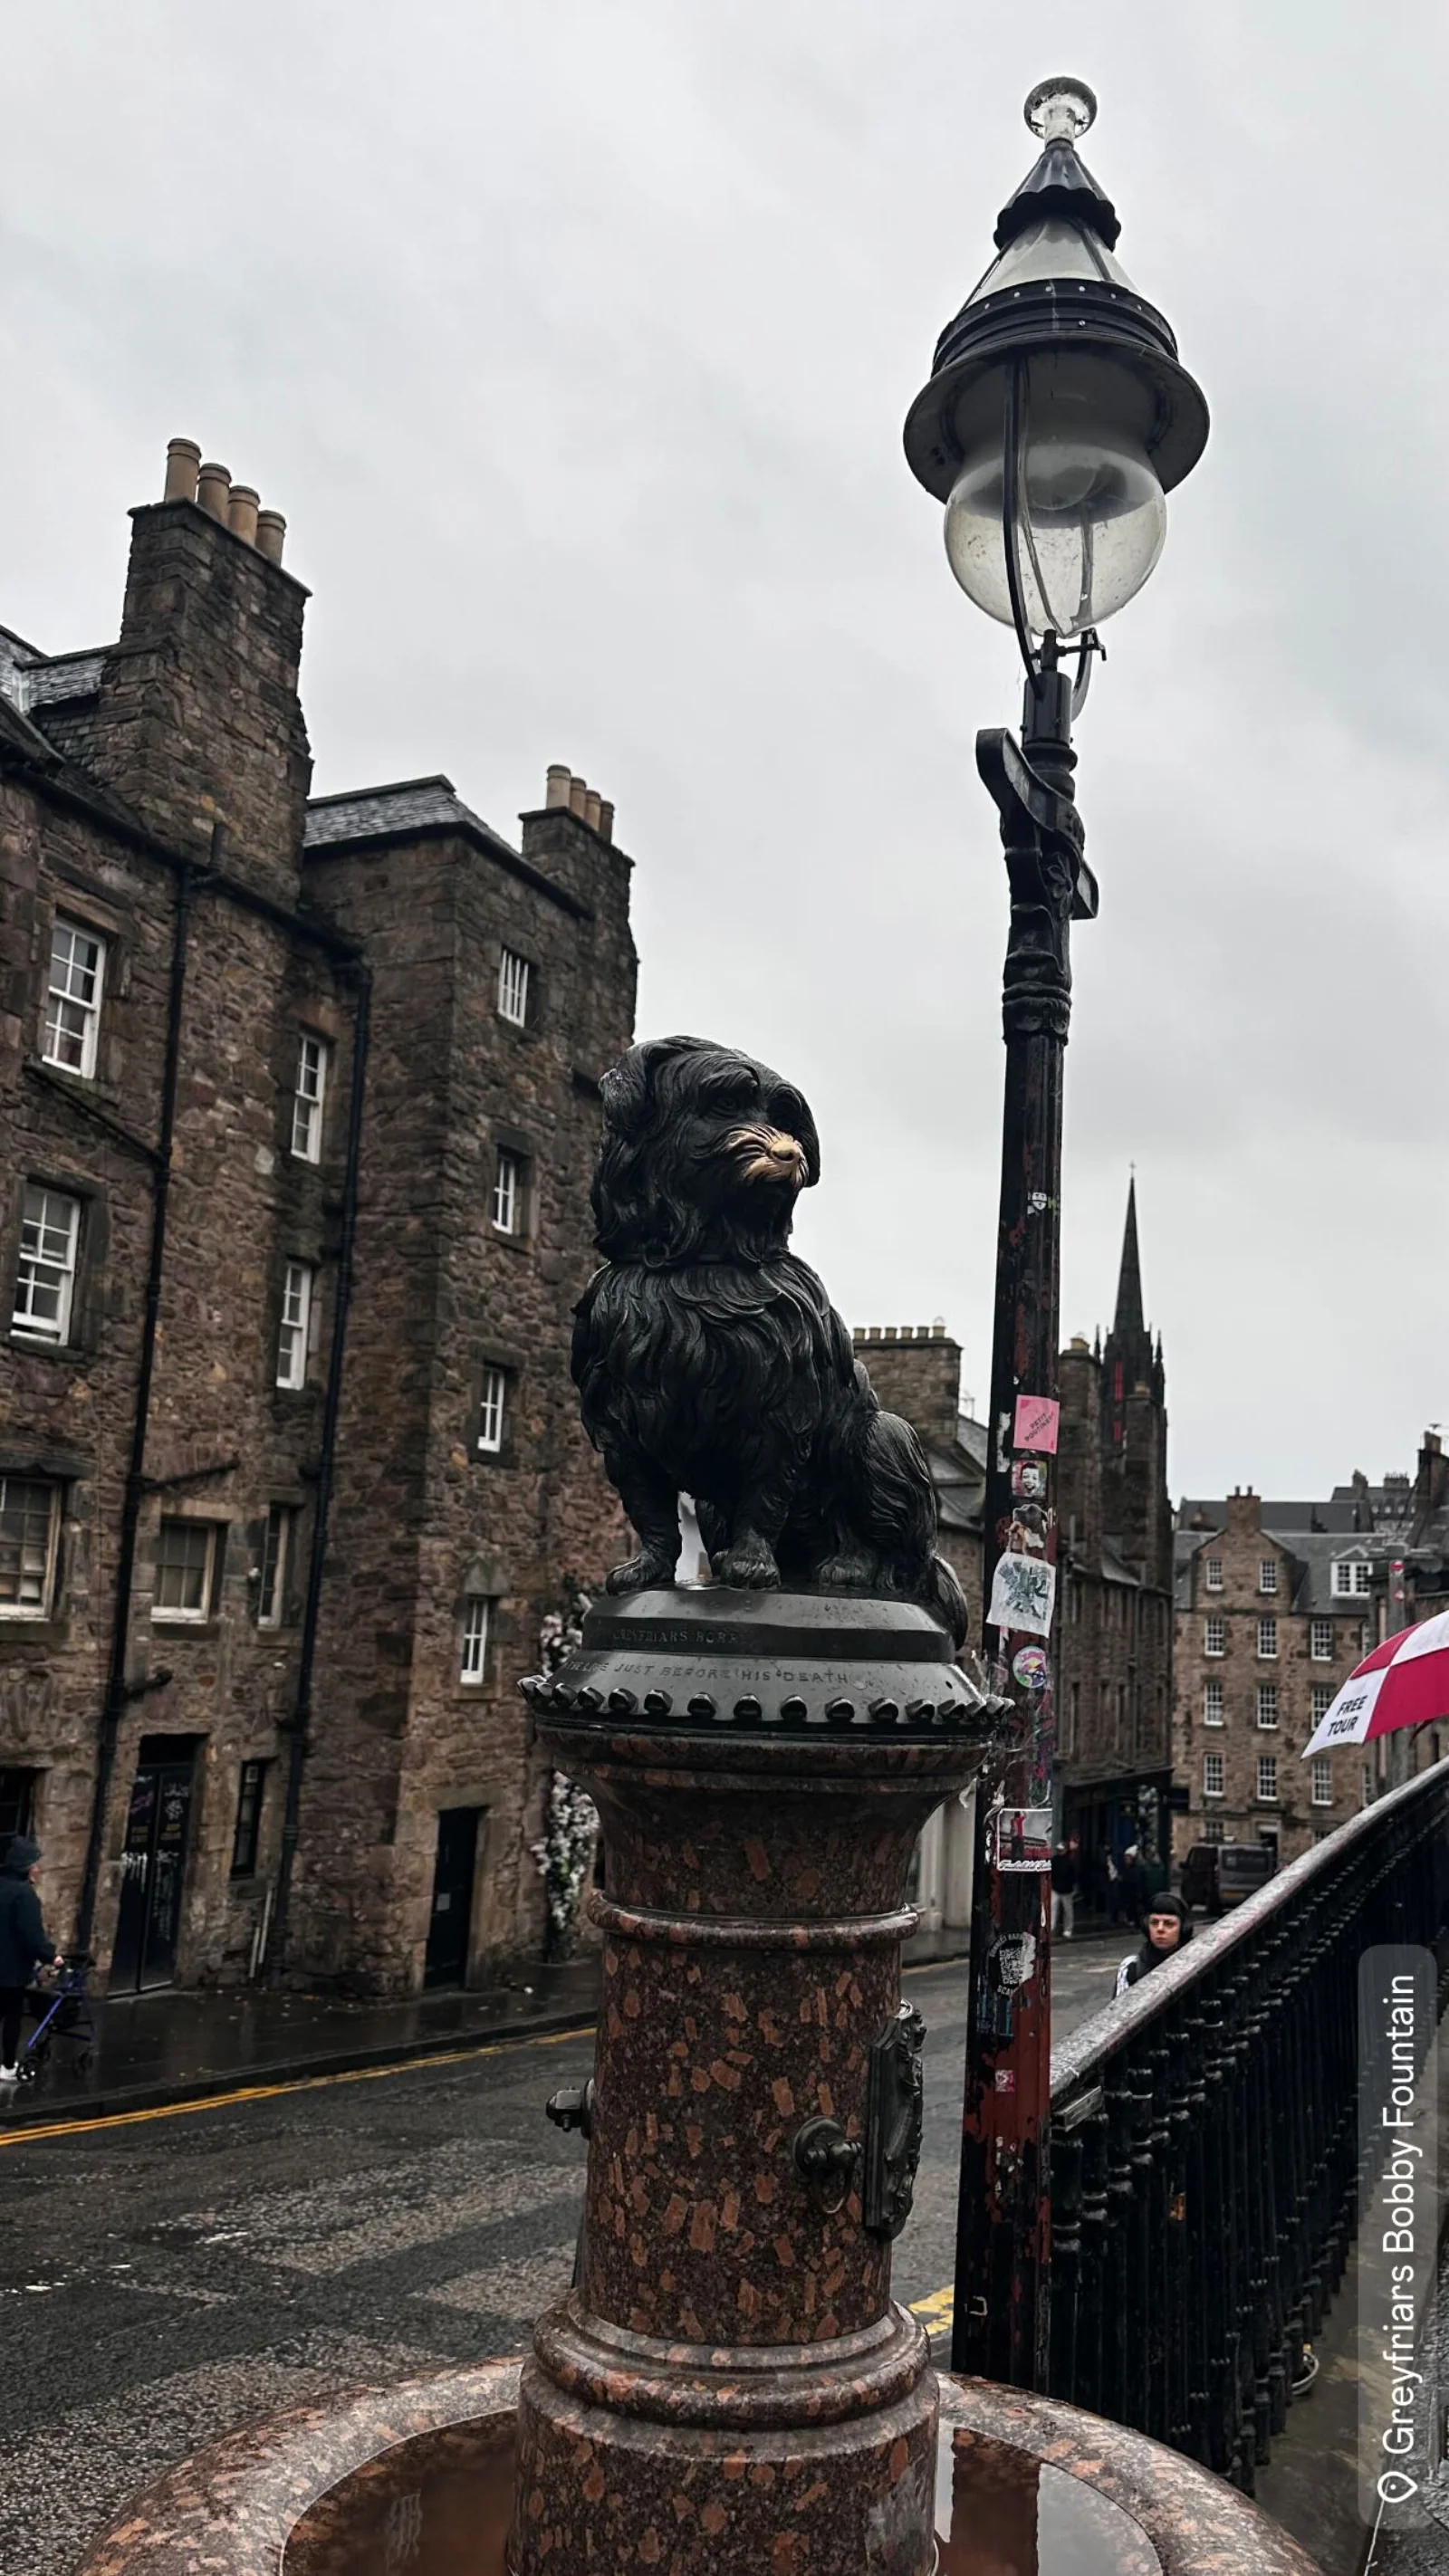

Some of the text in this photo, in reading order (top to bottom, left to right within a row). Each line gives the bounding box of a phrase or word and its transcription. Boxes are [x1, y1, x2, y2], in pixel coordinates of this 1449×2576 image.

[696, 1629, 742, 1645] BOBB
[614, 1662, 656, 1675] JUST
[659, 1666, 732, 1681] BEFORE
[741, 1669, 772, 1681] HIS
[782, 1670, 849, 1683] DEATH
[1336, 1694, 1368, 1717] FREE
[1327, 1716, 1359, 1738] TOUR
